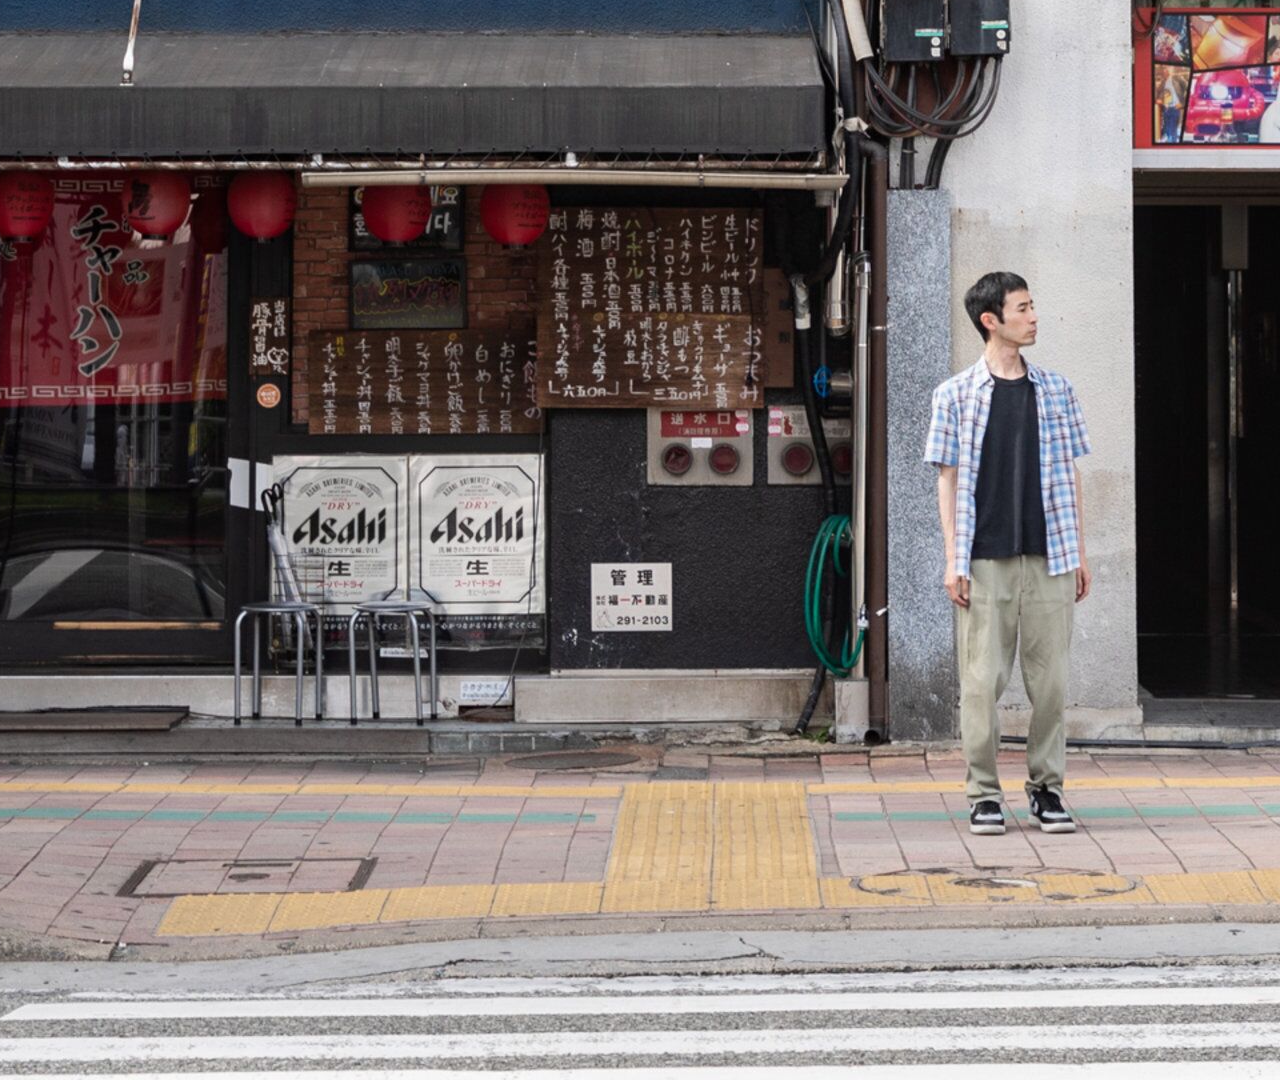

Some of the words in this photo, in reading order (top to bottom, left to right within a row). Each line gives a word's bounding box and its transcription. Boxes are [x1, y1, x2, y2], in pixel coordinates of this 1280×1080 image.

[70, 205, 122, 377] チャーハン
[292, 506, 387, 545] Asahi
[429, 505, 524, 544] Asahi
[327, 560, 352, 577] 生
[465, 559, 490, 576] 生
[610, 569, 654, 587] 管理
[616, 616, 669, 625] 291-2103
